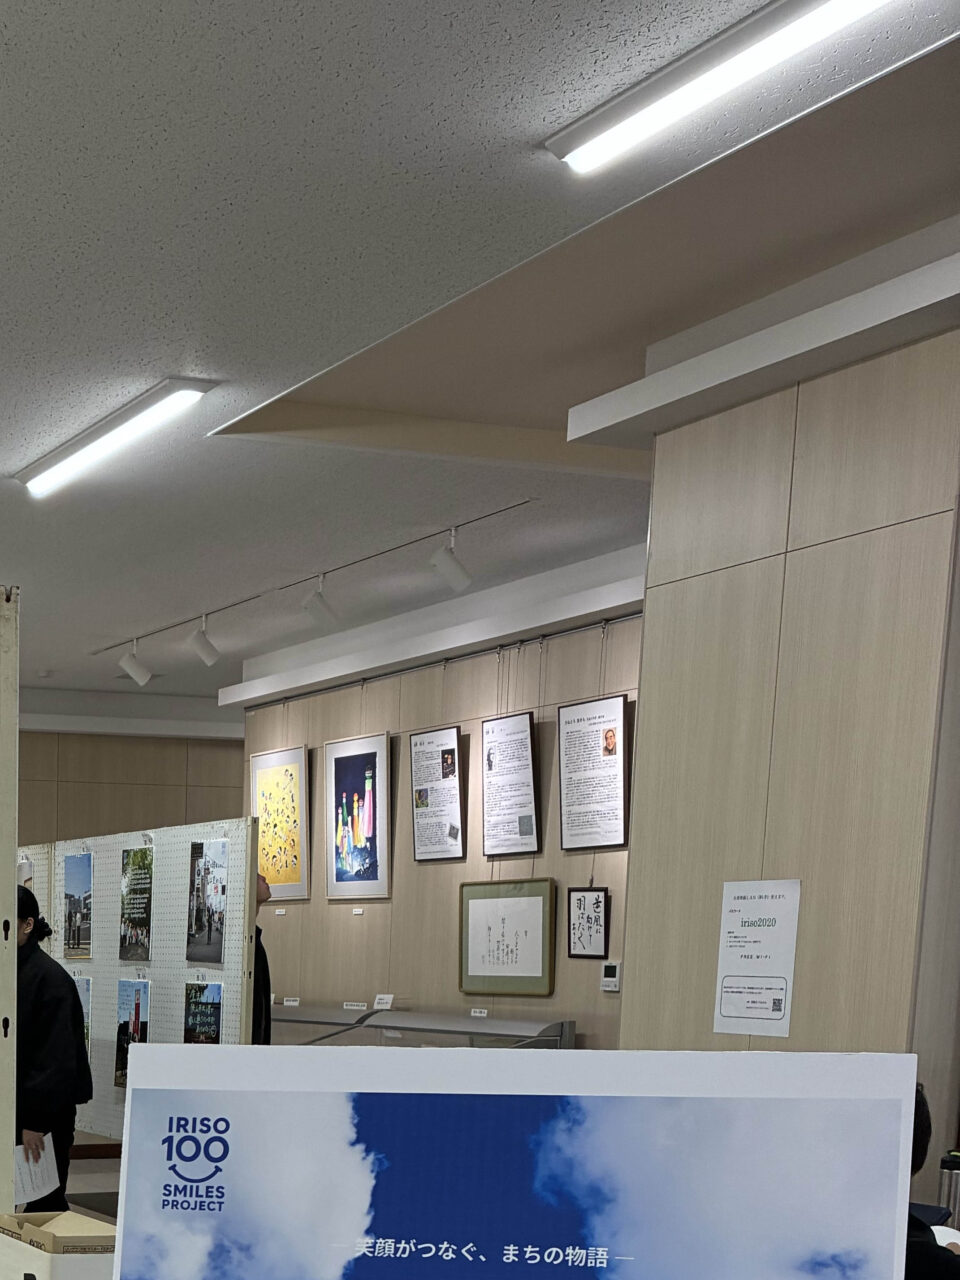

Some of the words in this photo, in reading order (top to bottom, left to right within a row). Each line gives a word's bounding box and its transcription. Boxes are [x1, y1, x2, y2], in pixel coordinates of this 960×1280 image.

[740, 918, 777, 928] iriso2020
[168, 1116, 230, 1134] IRISO
[161, 1135, 230, 1163] 100
[162, 1183, 225, 1199] SMILES
[162, 1199, 225, 1212] PROJECT
